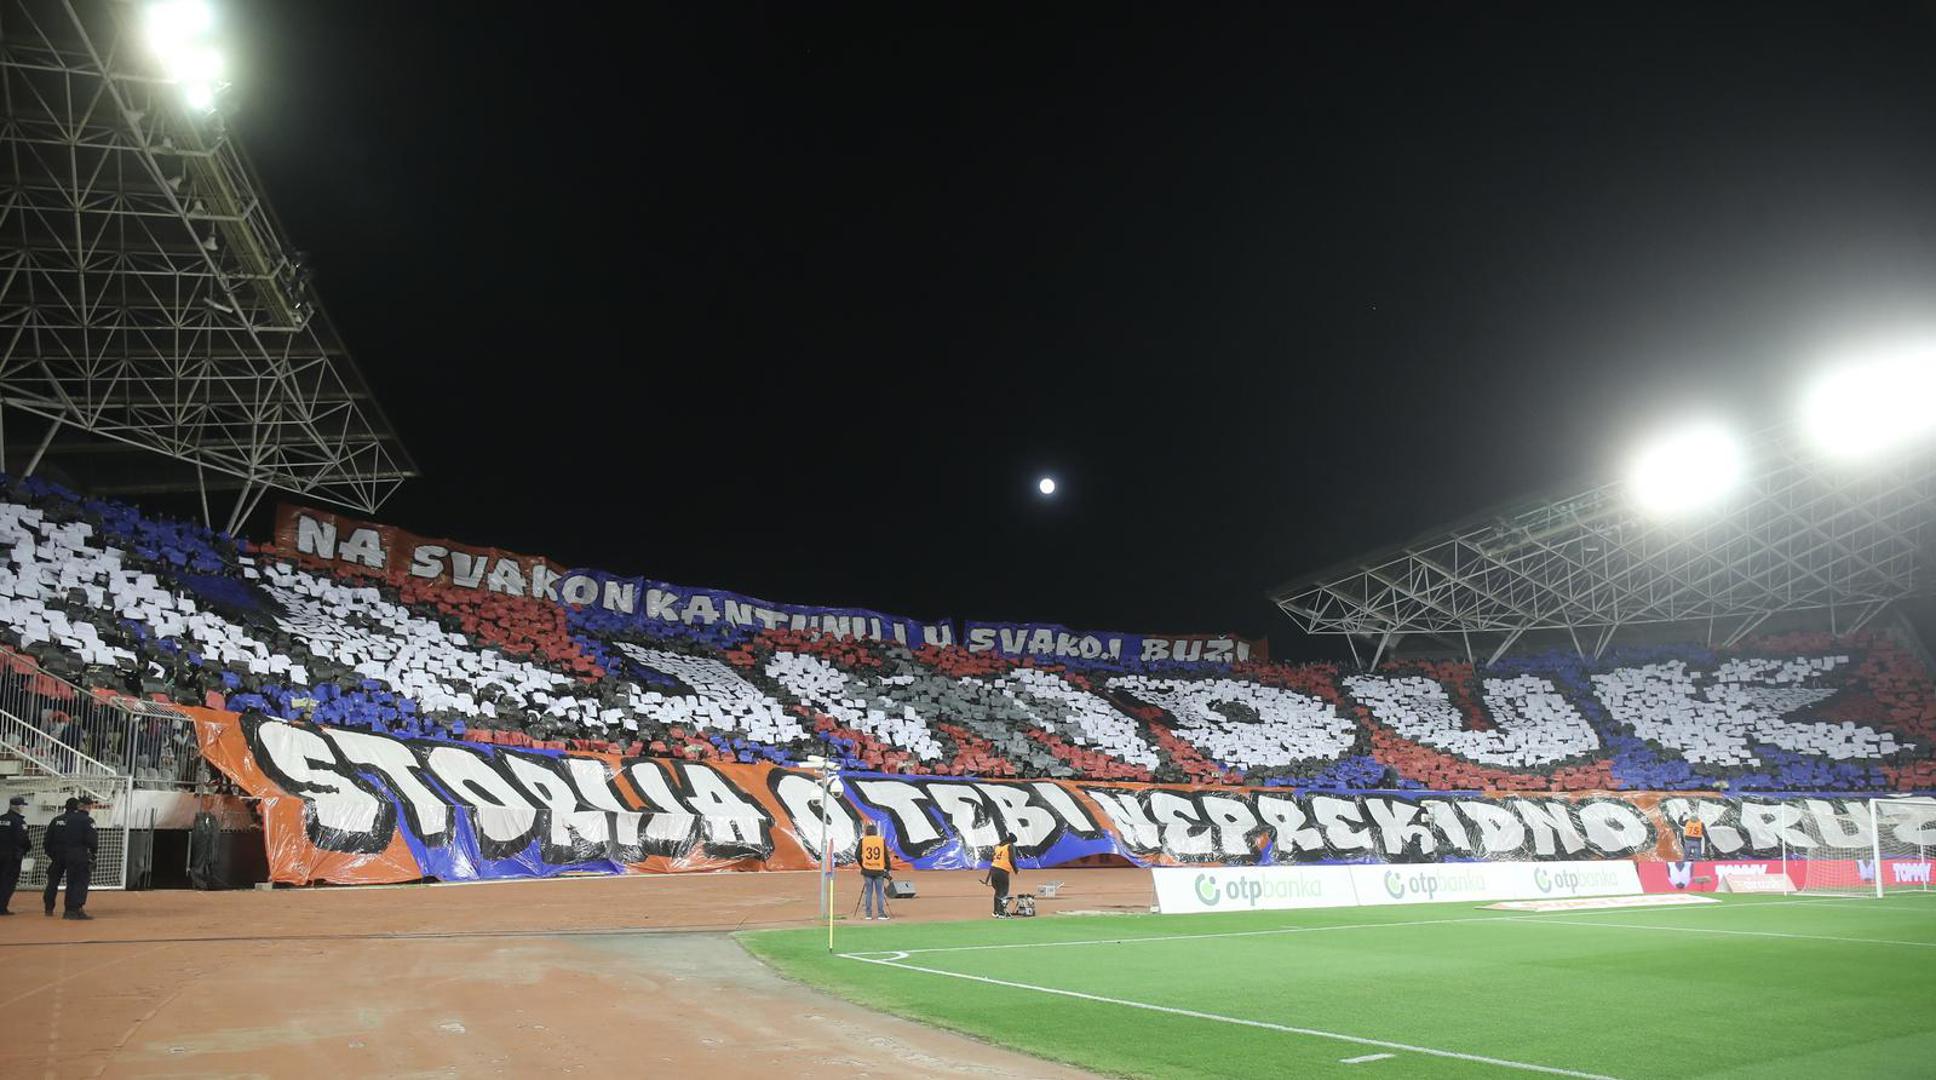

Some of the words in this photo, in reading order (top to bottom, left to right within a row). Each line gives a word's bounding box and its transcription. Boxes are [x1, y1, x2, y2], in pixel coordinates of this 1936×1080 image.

[297, 515, 387, 569] NA
[410, 545, 634, 614] SVAKON
[923, 624, 952, 648] U
[969, 629, 1122, 661] SVAKOJ
[1141, 633, 1250, 663] BUŽI
[257, 720, 773, 849] STORIJA
[777, 774, 857, 857] O
[855, 780, 1097, 848] TEBI
[1087, 790, 1648, 856] NEPREKIDNO
[865, 846, 881, 861] 39
[1892, 862, 1932, 882] TOMMY
